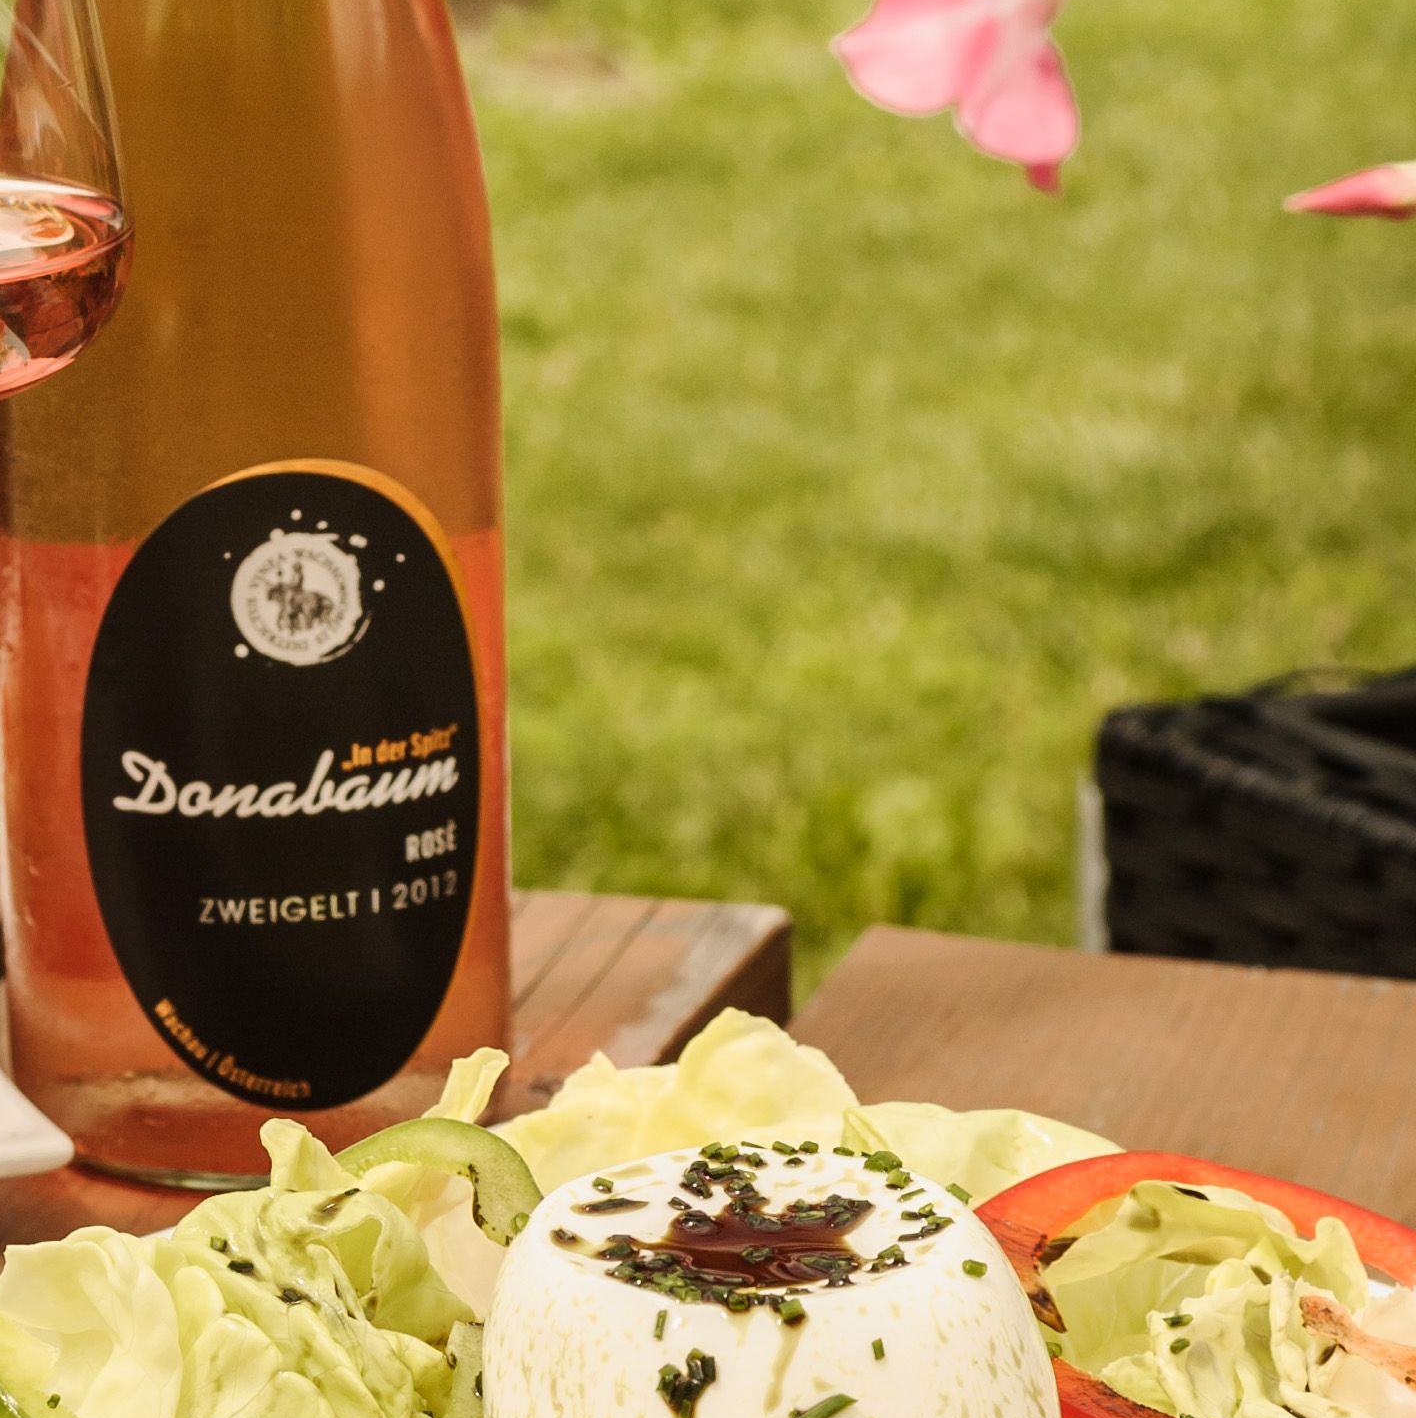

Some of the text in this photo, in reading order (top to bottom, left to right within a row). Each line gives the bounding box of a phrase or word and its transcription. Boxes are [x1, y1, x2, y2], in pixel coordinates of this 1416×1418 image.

[376, 739, 407, 764] der
[112, 748, 460, 818] Donabaum
[405, 819, 457, 863] ROSÉ
[199, 890, 360, 924] ZWEIGELT
[392, 869, 457, 910] 2012
